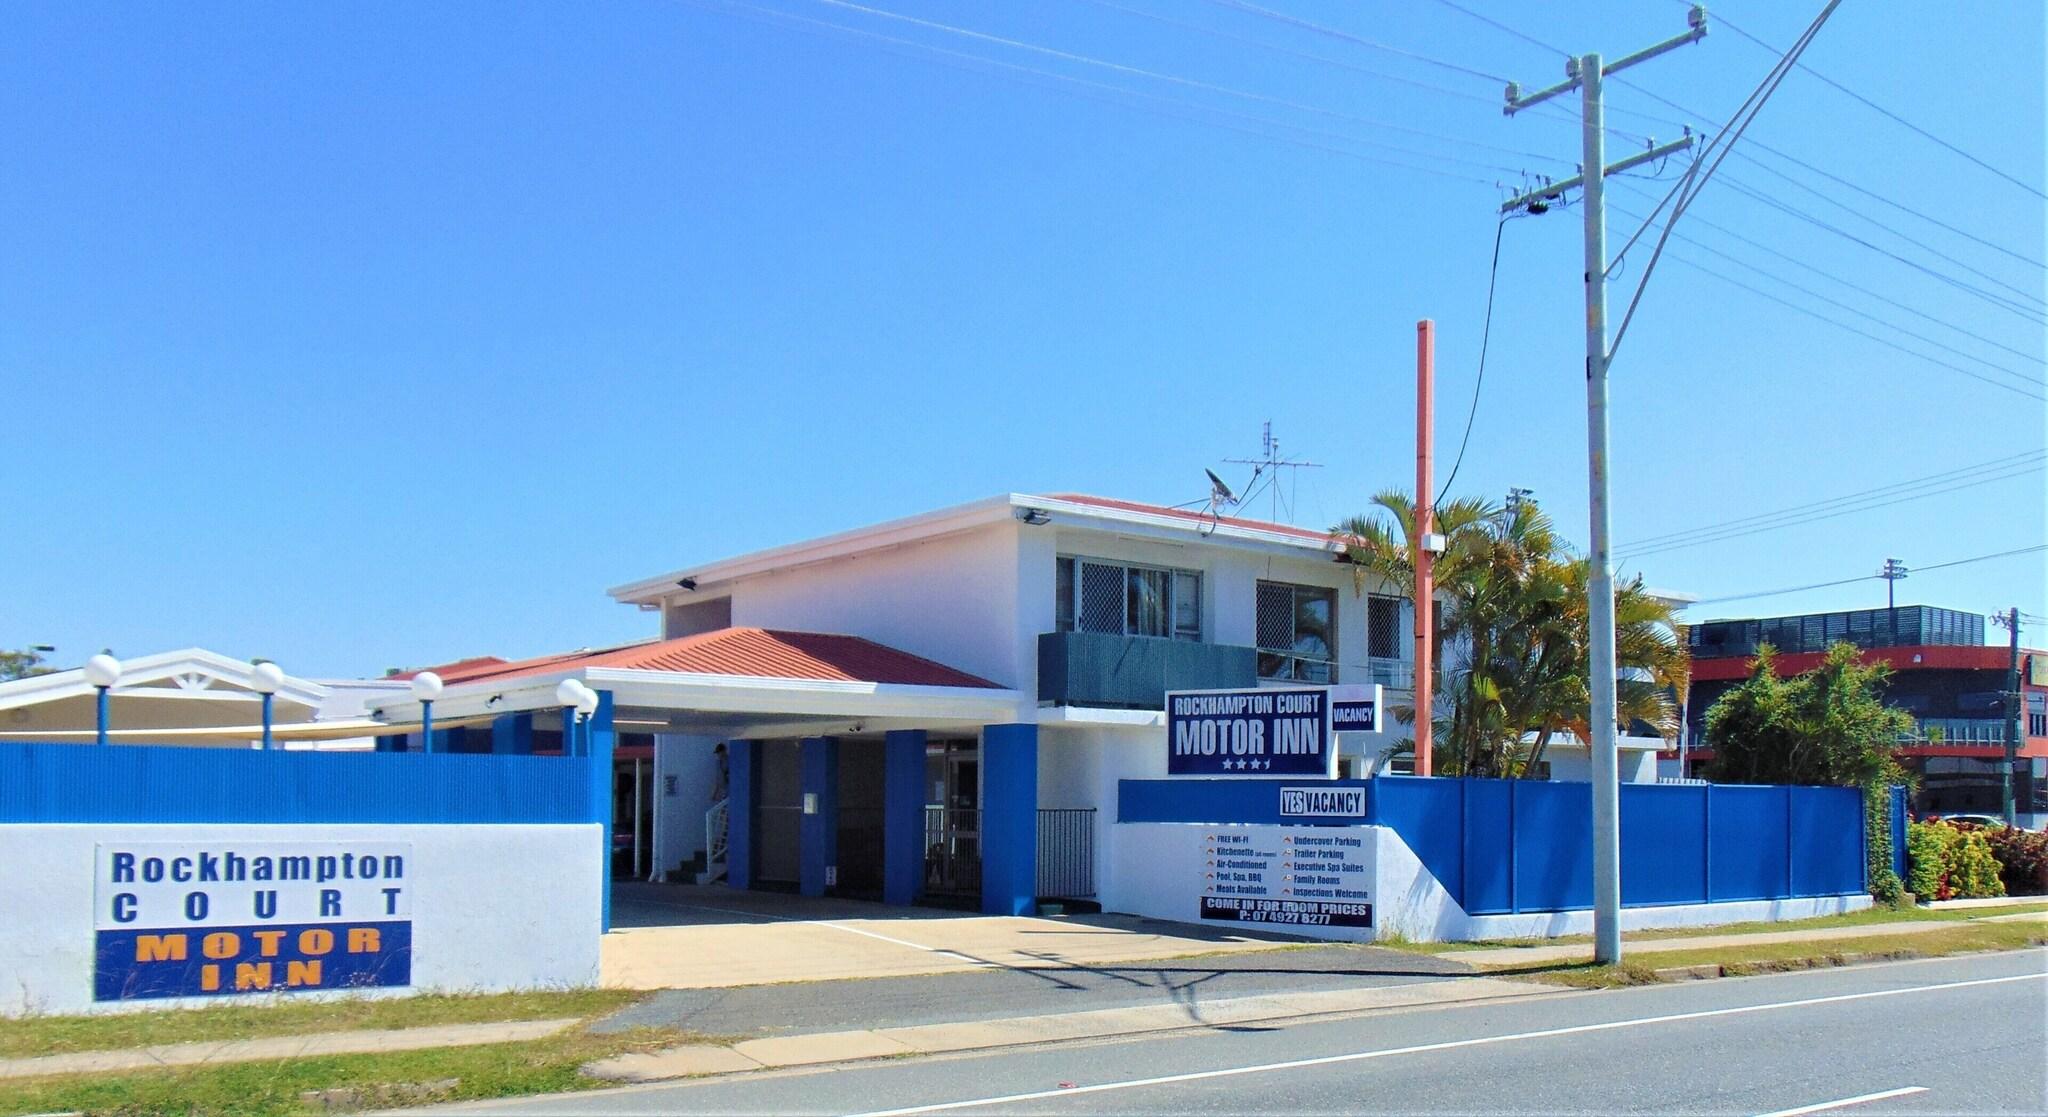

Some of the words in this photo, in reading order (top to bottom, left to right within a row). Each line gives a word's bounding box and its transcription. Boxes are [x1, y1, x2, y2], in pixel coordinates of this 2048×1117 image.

[1175, 695, 1273, 716] ROCKHAMPTON
[1276, 694, 1321, 714] COURT
[1333, 706, 1373, 723] VACANCY
[1175, 719, 1265, 755] MOTOR
[1273, 718, 1320, 755] INN
[1283, 791, 1304, 813] YES
[1306, 793, 1361, 812] VACANCY
[1217, 835, 1232, 843] FREE
[1232, 835, 1249, 844] WI-FI
[1293, 836, 1333, 846] Undercover
[1334, 837, 1362, 848] Parking
[1216, 847, 1255, 857] Kitchenette
[1294, 849, 1317, 859] Trailer
[1317, 850, 1345, 860] Parking
[110, 851, 404, 883] Rockhampton
[1216, 860, 1267, 869] Air-Conditioned
[1294, 862, 1326, 872] Executive
[1327, 863, 1341, 873] Spa
[1341, 863, 1364, 873] Suites
[1248, 873, 1262, 883] BBQ
[1294, 875, 1316, 885] Family
[1317, 876, 1341, 885] Rooms
[1216, 884, 1236, 894] Meals
[1237, 885, 1267, 895] Available
[1293, 888, 1334, 898] Inspections
[1335, 889, 1368, 899] Welcome
[111, 887, 402, 923] COURT
[1207, 898, 1240, 910] COME
[1242, 899, 1255, 910] IN
[1257, 901, 1280, 912] FOR
[1321, 904, 1366, 916] PRICES
[1240, 910, 1251, 921] P:
[1252, 911, 1268, 921] 07
[1269, 912, 1299, 923] 4927
[1301, 914, 1331, 925] 8277
[135, 928, 382, 962] MOTOR
[201, 959, 323, 991] INN
